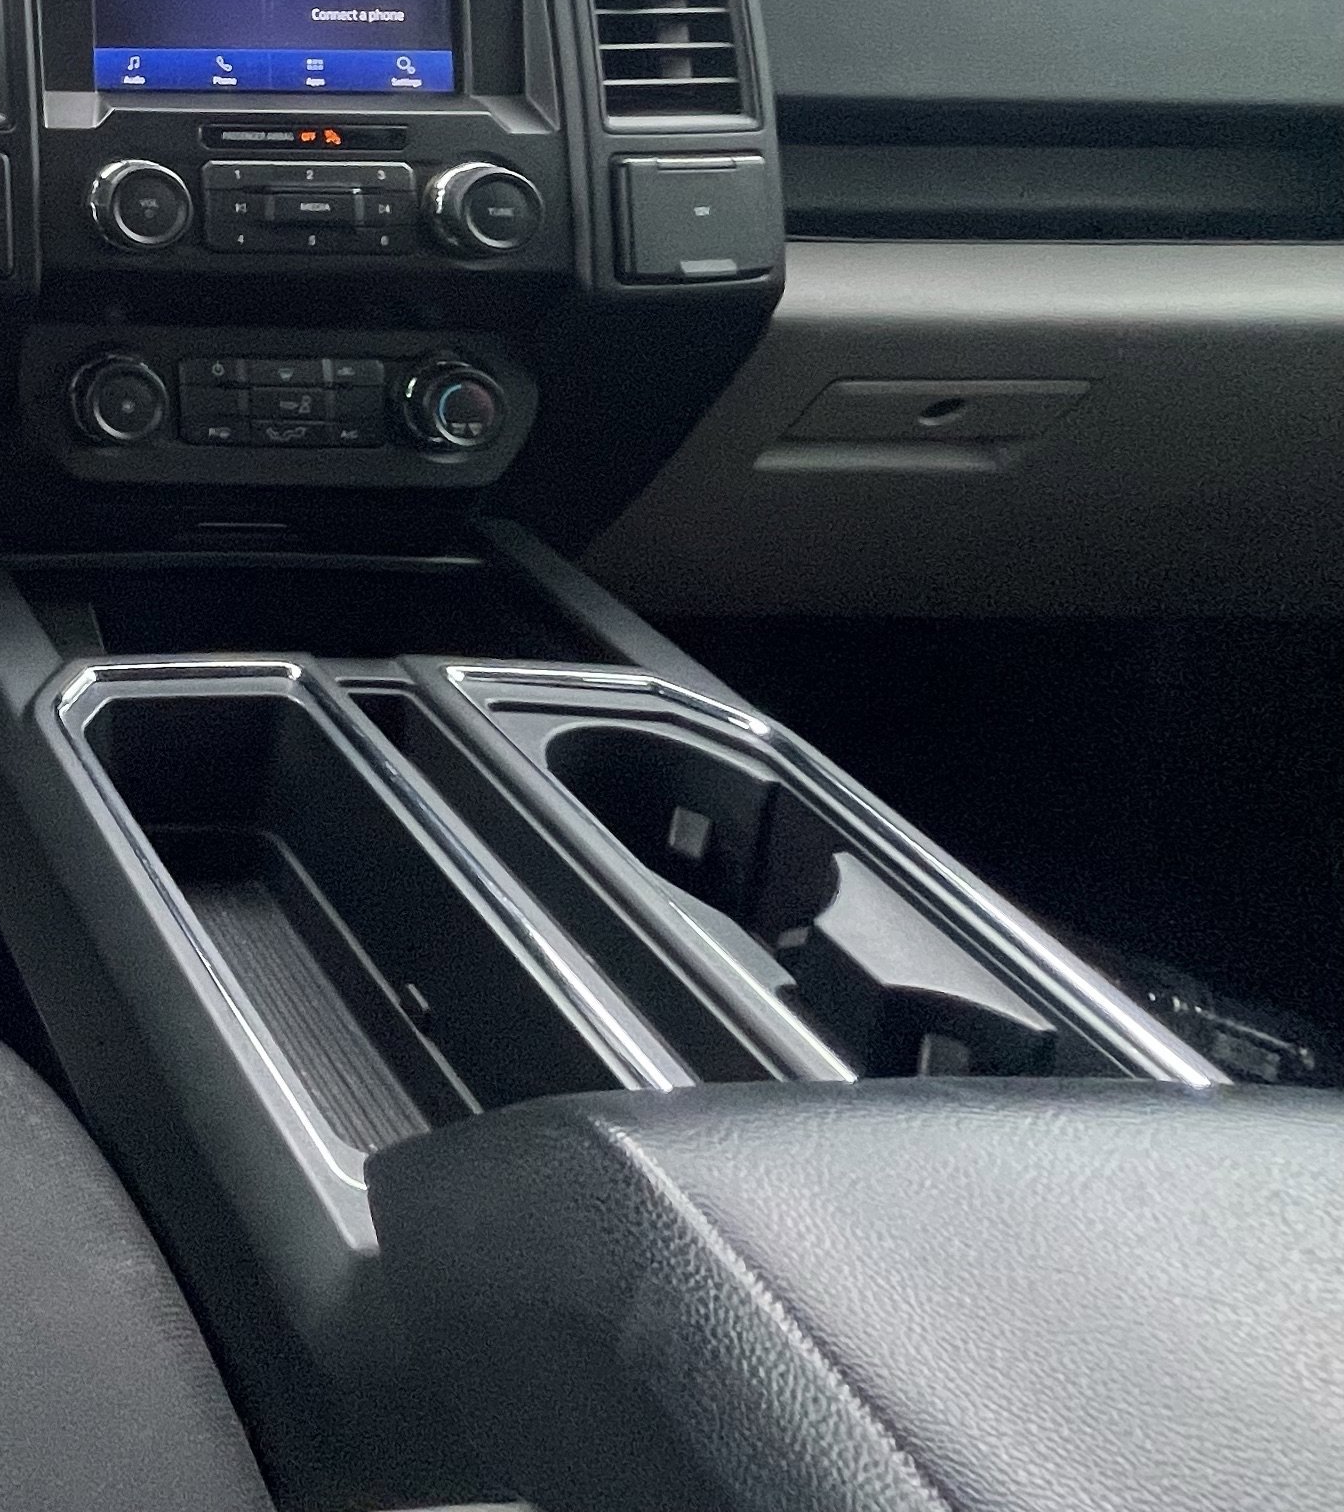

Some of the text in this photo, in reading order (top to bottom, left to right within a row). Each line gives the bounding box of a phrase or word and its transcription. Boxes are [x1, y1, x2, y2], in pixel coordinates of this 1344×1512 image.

[311, 8, 405, 23] Connect a phone
[234, 169, 241, 180] 1
[306, 169, 313, 180] 2
[377, 169, 386, 181] 3
